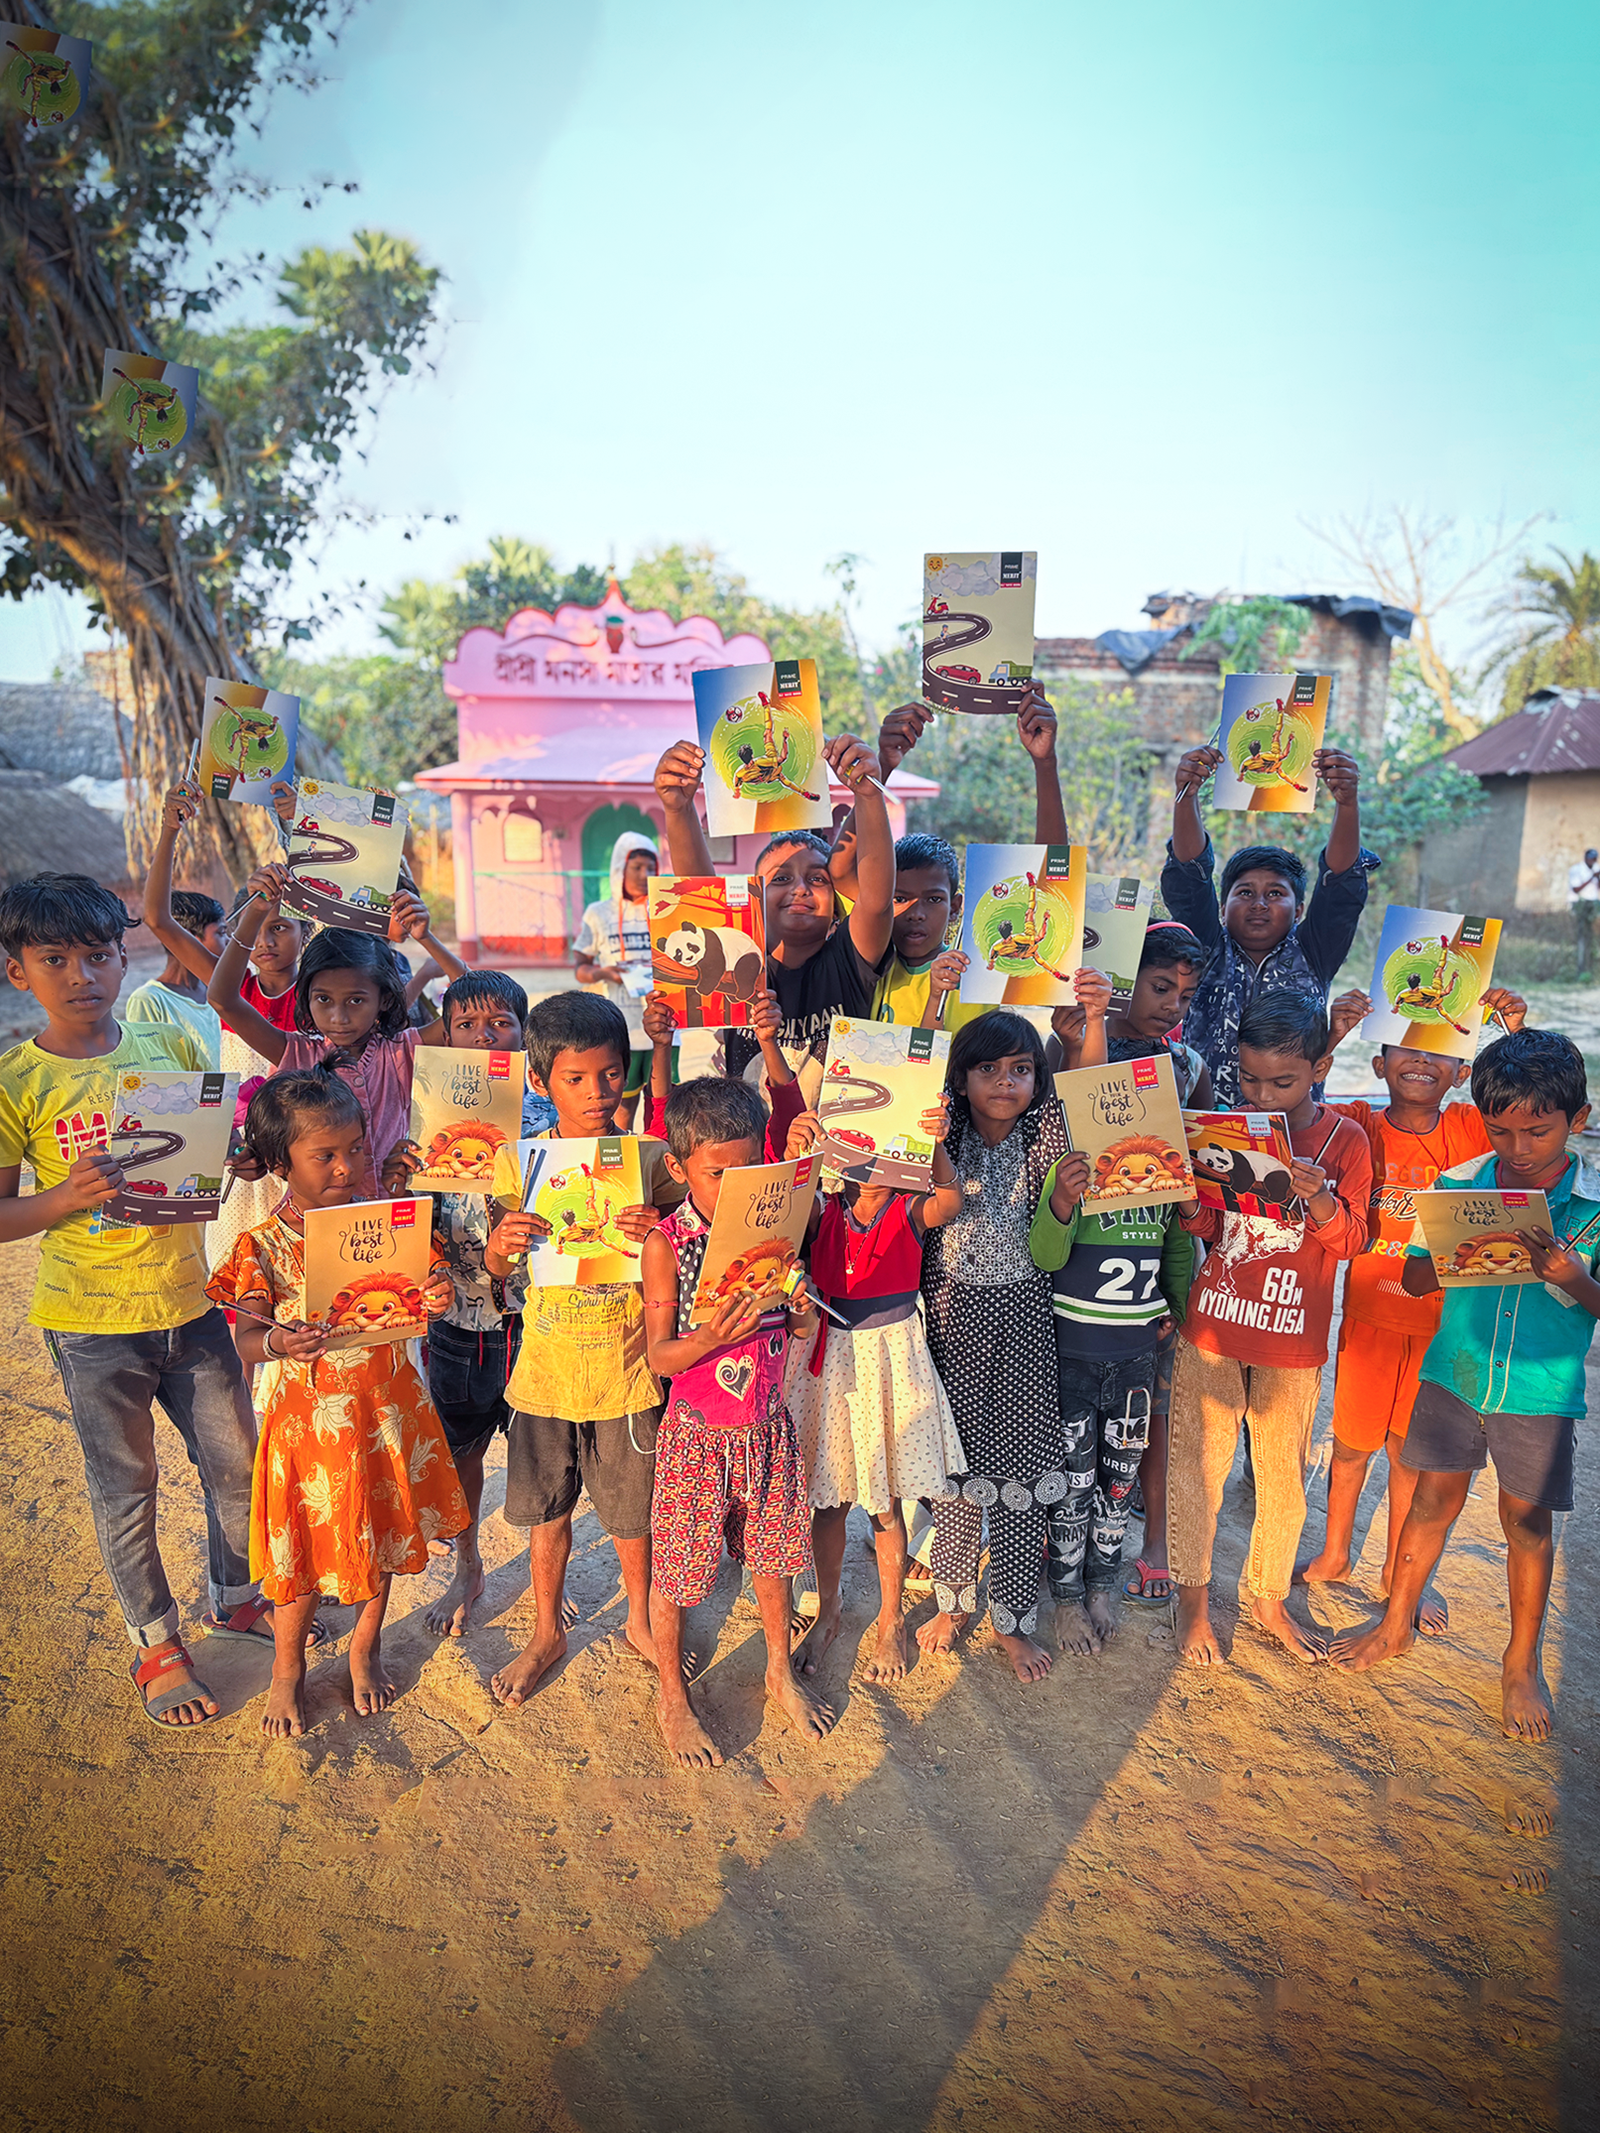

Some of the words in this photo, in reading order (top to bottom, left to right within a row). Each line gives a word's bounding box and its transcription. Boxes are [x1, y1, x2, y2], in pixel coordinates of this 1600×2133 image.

[16, 1061, 43, 1079] ORIGINAL
[113, 1061, 140, 1070] ORIGINAL
[456, 1064, 481, 1076] LIVE
[71, 1070, 102, 1080] ORIGINAL
[451, 1076, 482, 1095] best
[1100, 1079, 1128, 1094] LIVE
[453, 1090, 479, 1109] life
[1100, 1094, 1134, 1111] best
[1105, 1110, 1134, 1126] life
[1375, 1161, 1440, 1185] LEGEN
[764, 1179, 788, 1195] LIVE
[756, 1194, 785, 1213] best
[355, 1217, 383, 1232] LIVE
[755, 1212, 780, 1229] life
[350, 1232, 385, 1249] best
[1122, 1231, 1158, 1240] STYLE
[353, 1247, 383, 1264] life
[1095, 1257, 1160, 1301] 27
